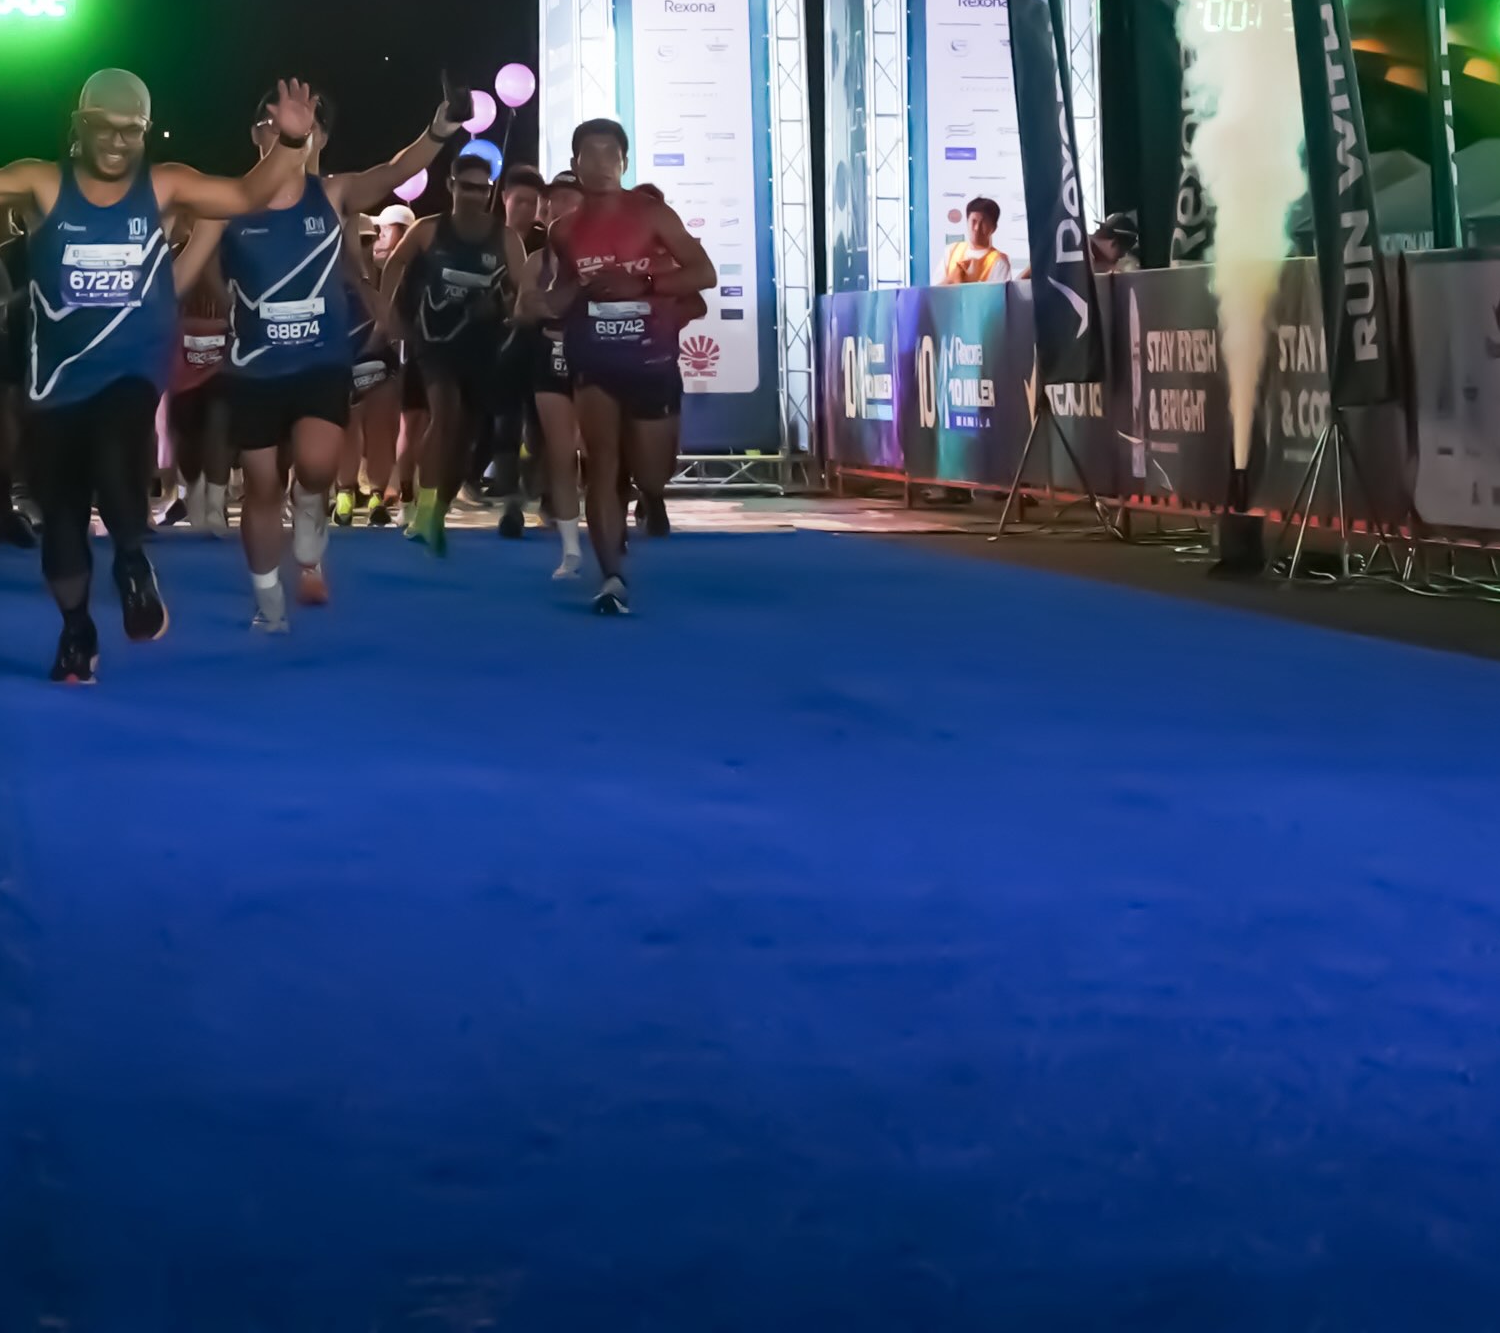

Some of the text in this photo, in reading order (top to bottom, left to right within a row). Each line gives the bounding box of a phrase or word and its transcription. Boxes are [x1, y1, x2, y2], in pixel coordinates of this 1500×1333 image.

[664, 0, 716, 14] Rexona
[69, 270, 135, 291] 67278
[1343, 209, 1379, 363] RUN
